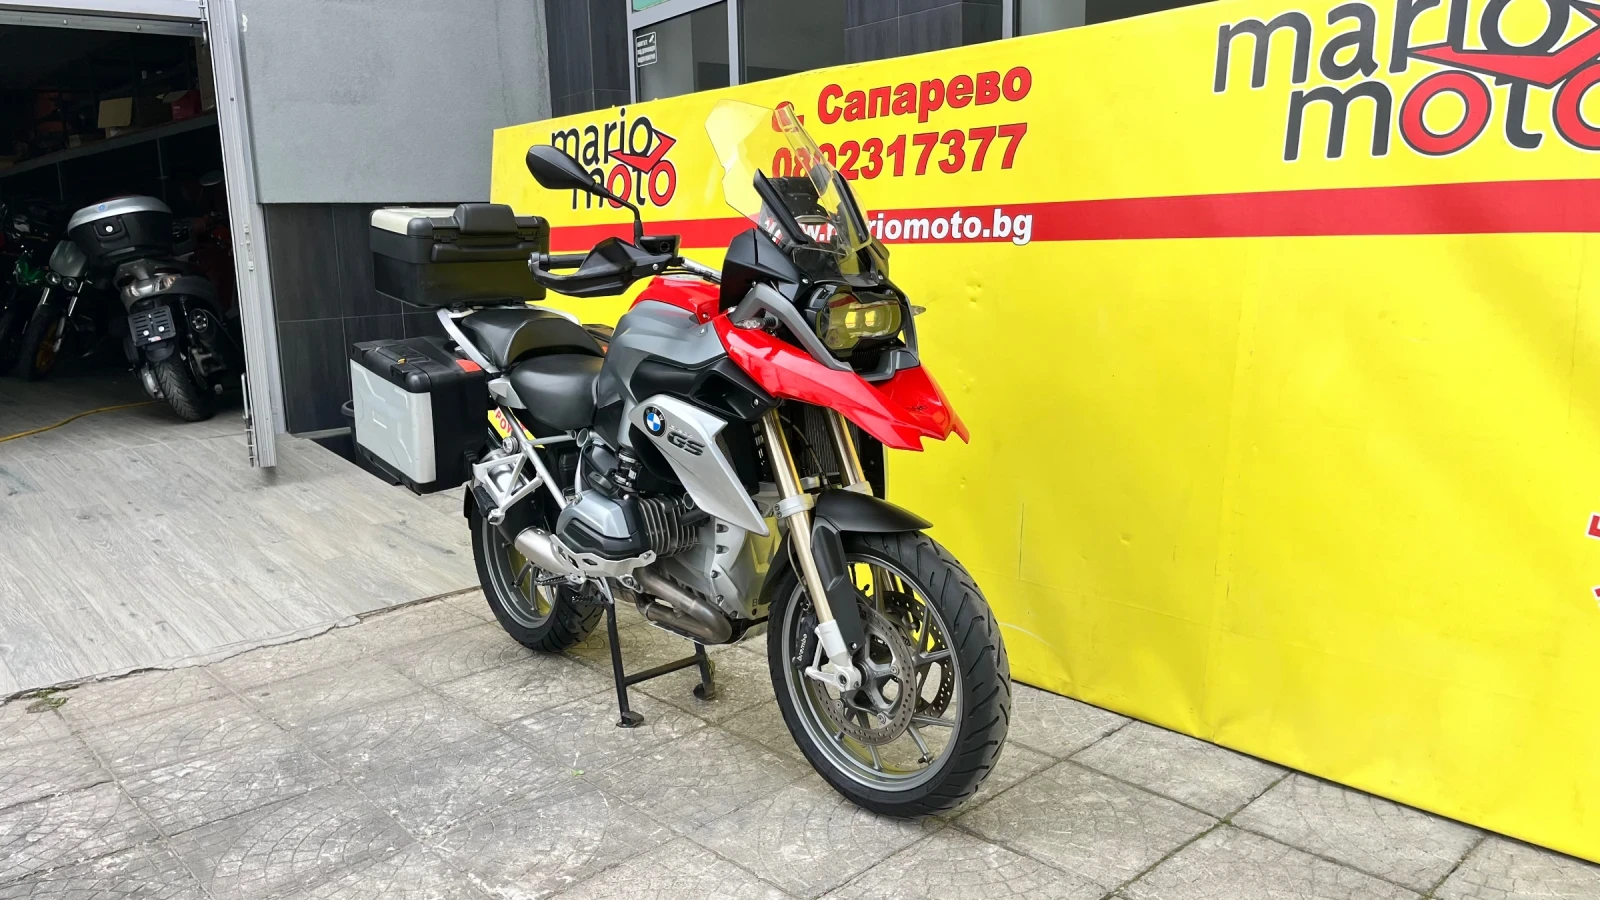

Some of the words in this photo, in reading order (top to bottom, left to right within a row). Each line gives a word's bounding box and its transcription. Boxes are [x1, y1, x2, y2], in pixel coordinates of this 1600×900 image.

[1214, 0, 1571, 92] mario
[817, 66, 1032, 123] Сапарево
[551, 107, 655, 166] mario
[667, 430, 705, 456] GS
